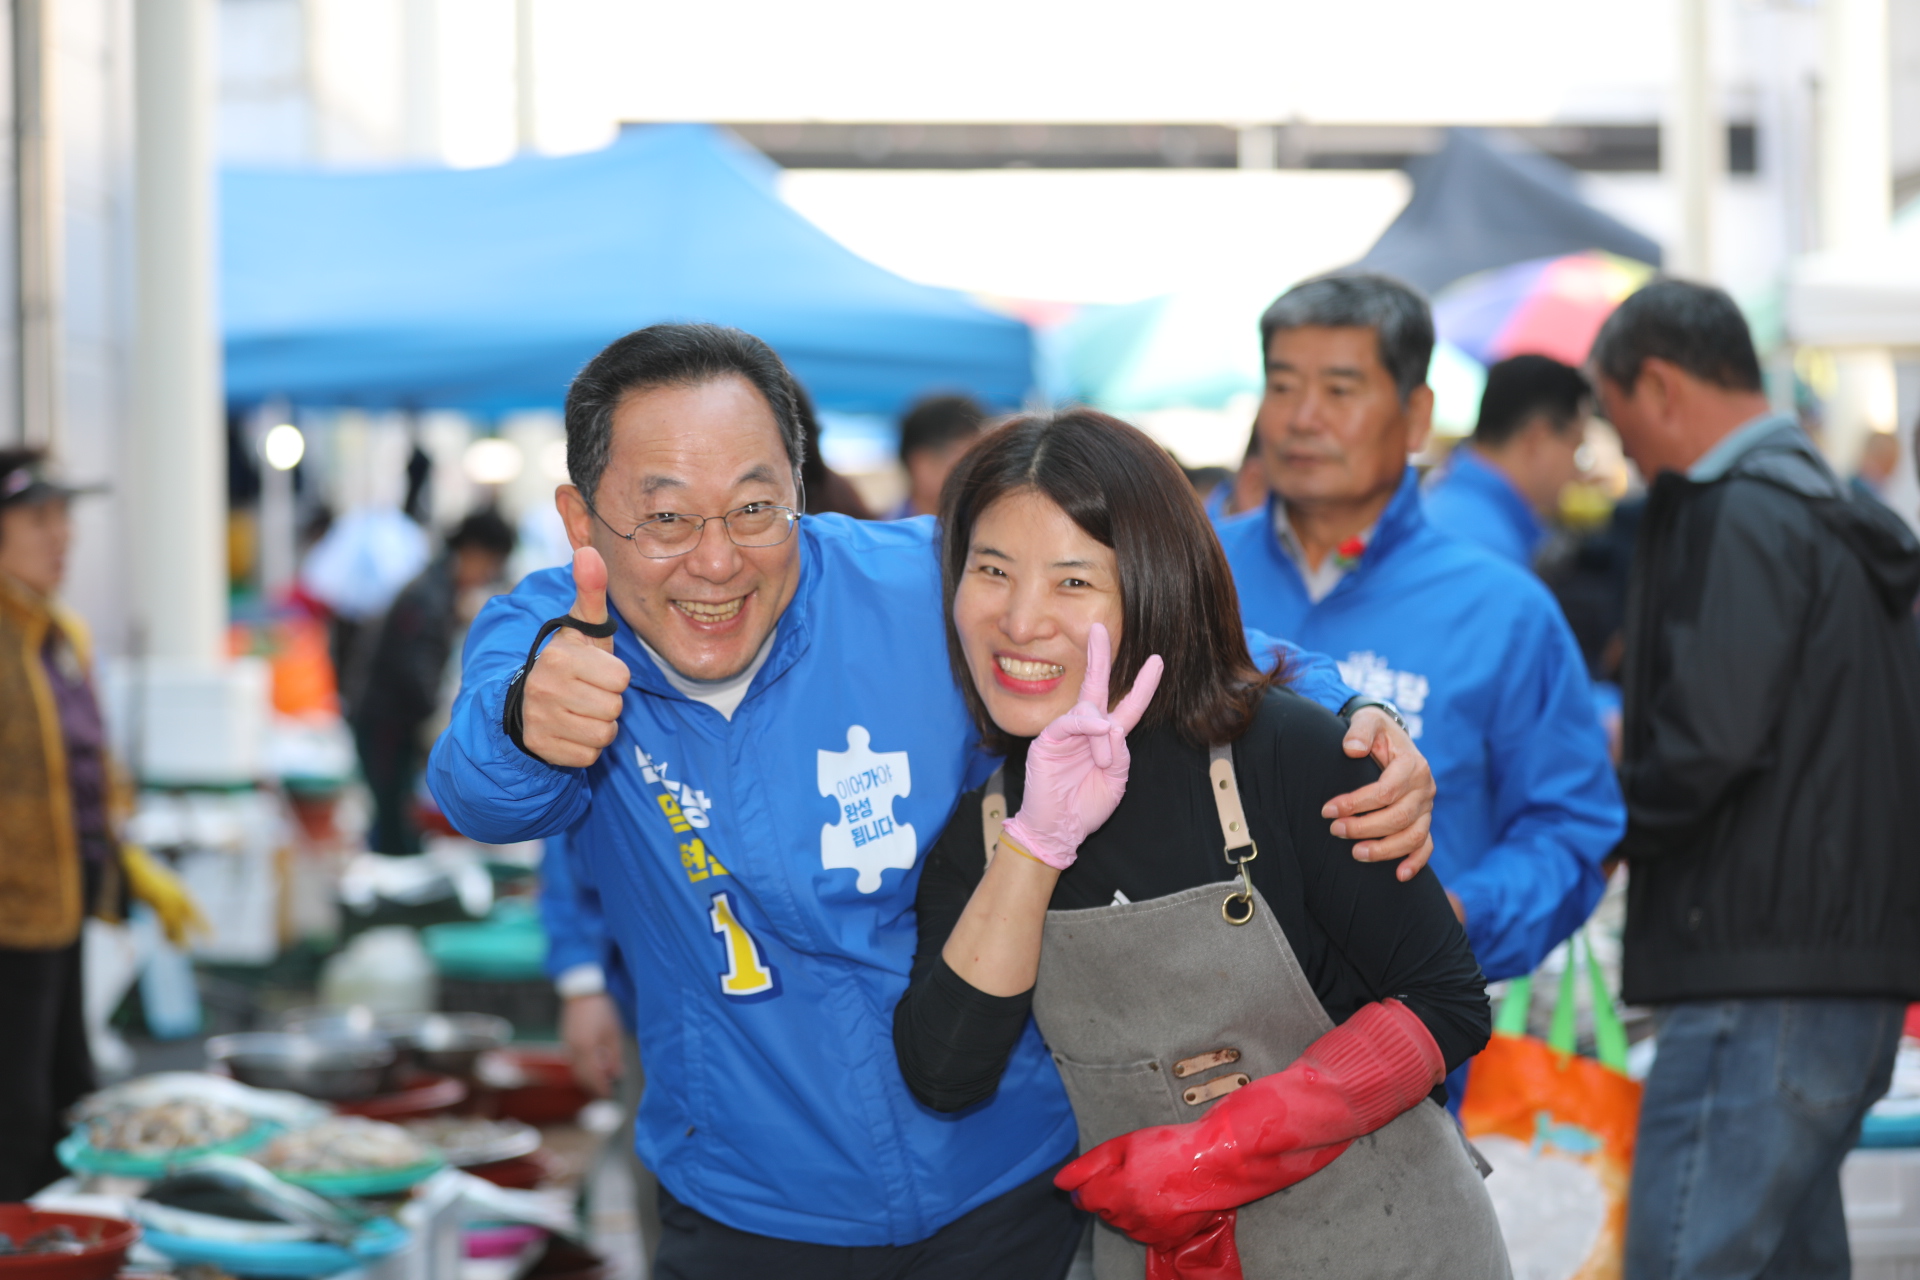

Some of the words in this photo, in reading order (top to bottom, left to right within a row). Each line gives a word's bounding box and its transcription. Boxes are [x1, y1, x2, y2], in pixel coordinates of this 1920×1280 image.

[836, 763, 893, 800] 이어가야
[844, 797, 873, 825] 완성
[851, 815, 894, 848] 됩니다
[710, 893, 773, 996] 1
